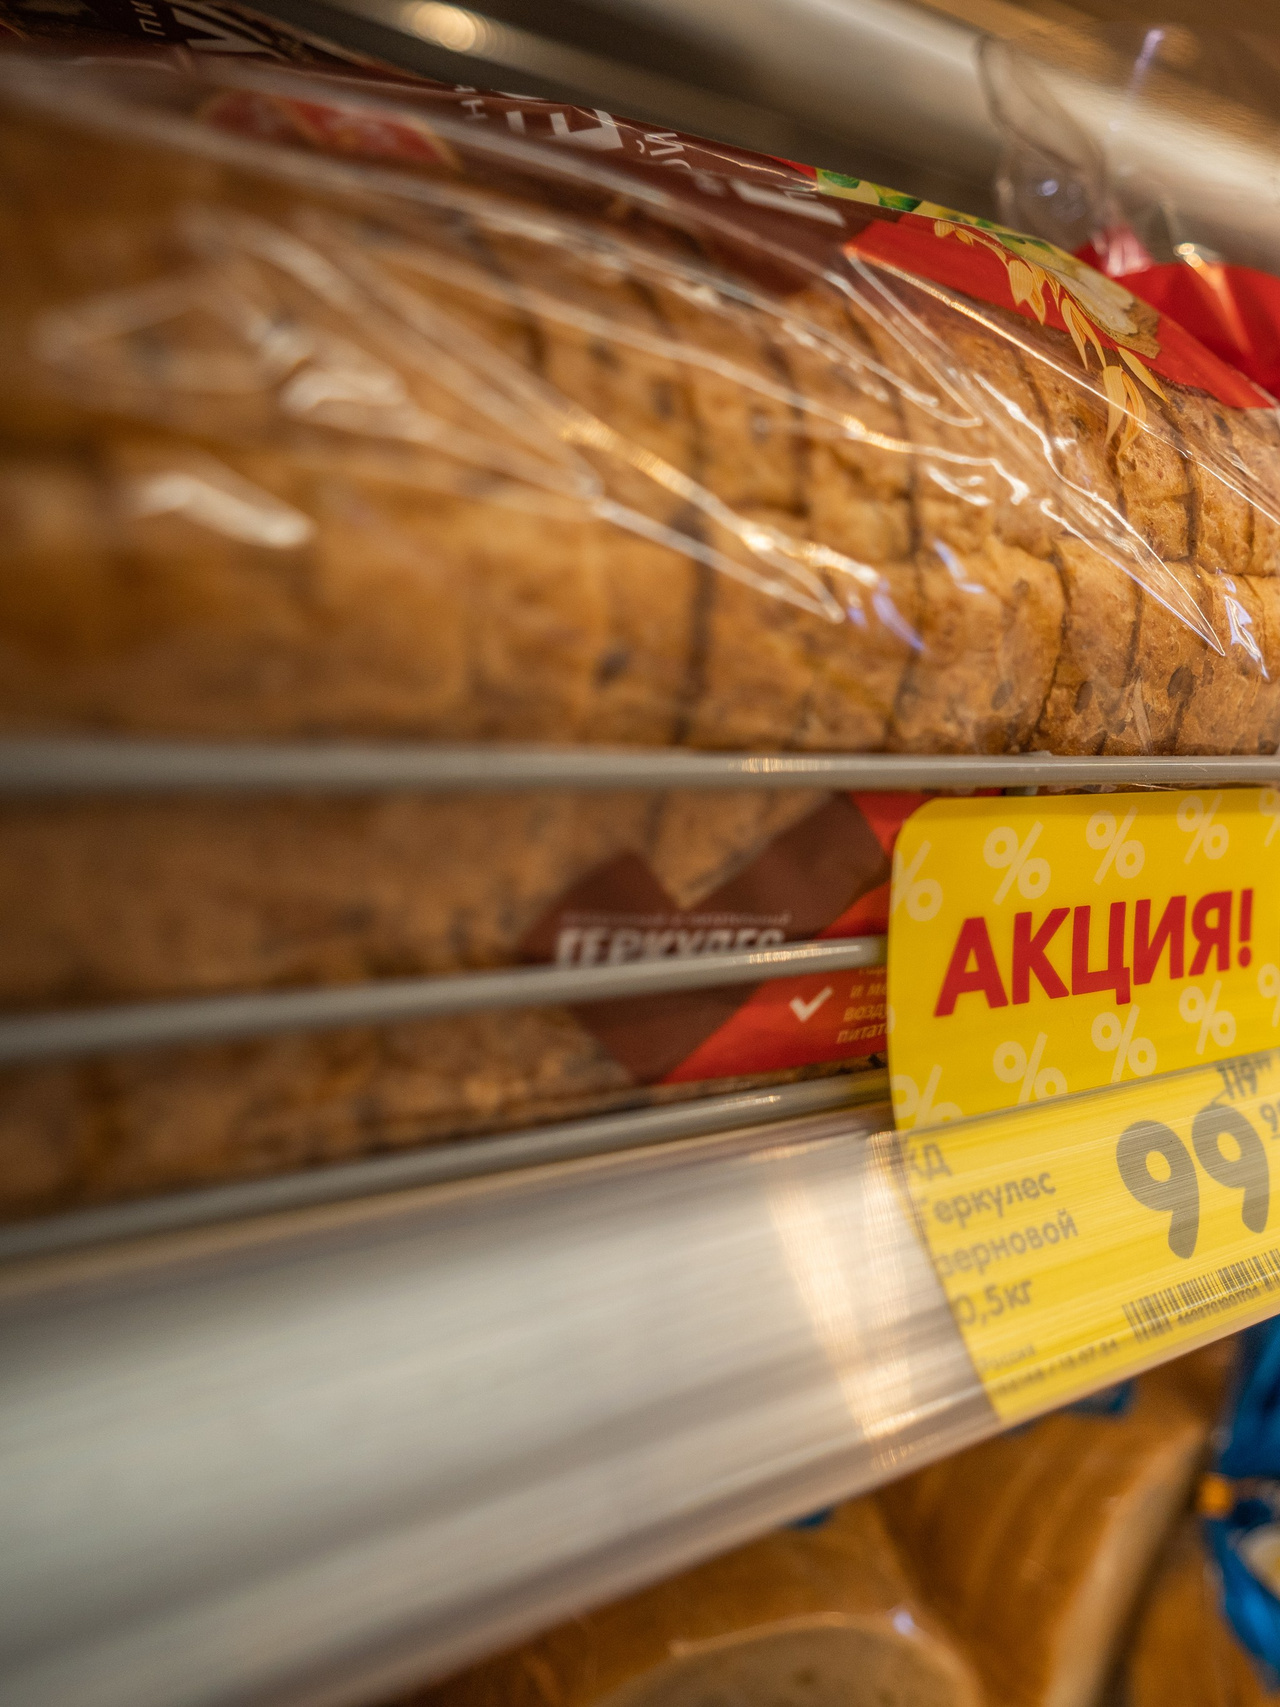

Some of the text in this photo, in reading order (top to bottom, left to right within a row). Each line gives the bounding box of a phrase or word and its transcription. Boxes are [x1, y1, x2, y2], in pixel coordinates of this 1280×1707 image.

[933, 888, 1254, 1018] АКЦИЯ!
[922, 1171, 1057, 1229] еркулес
[1116, 1103, 1270, 1260] 99
